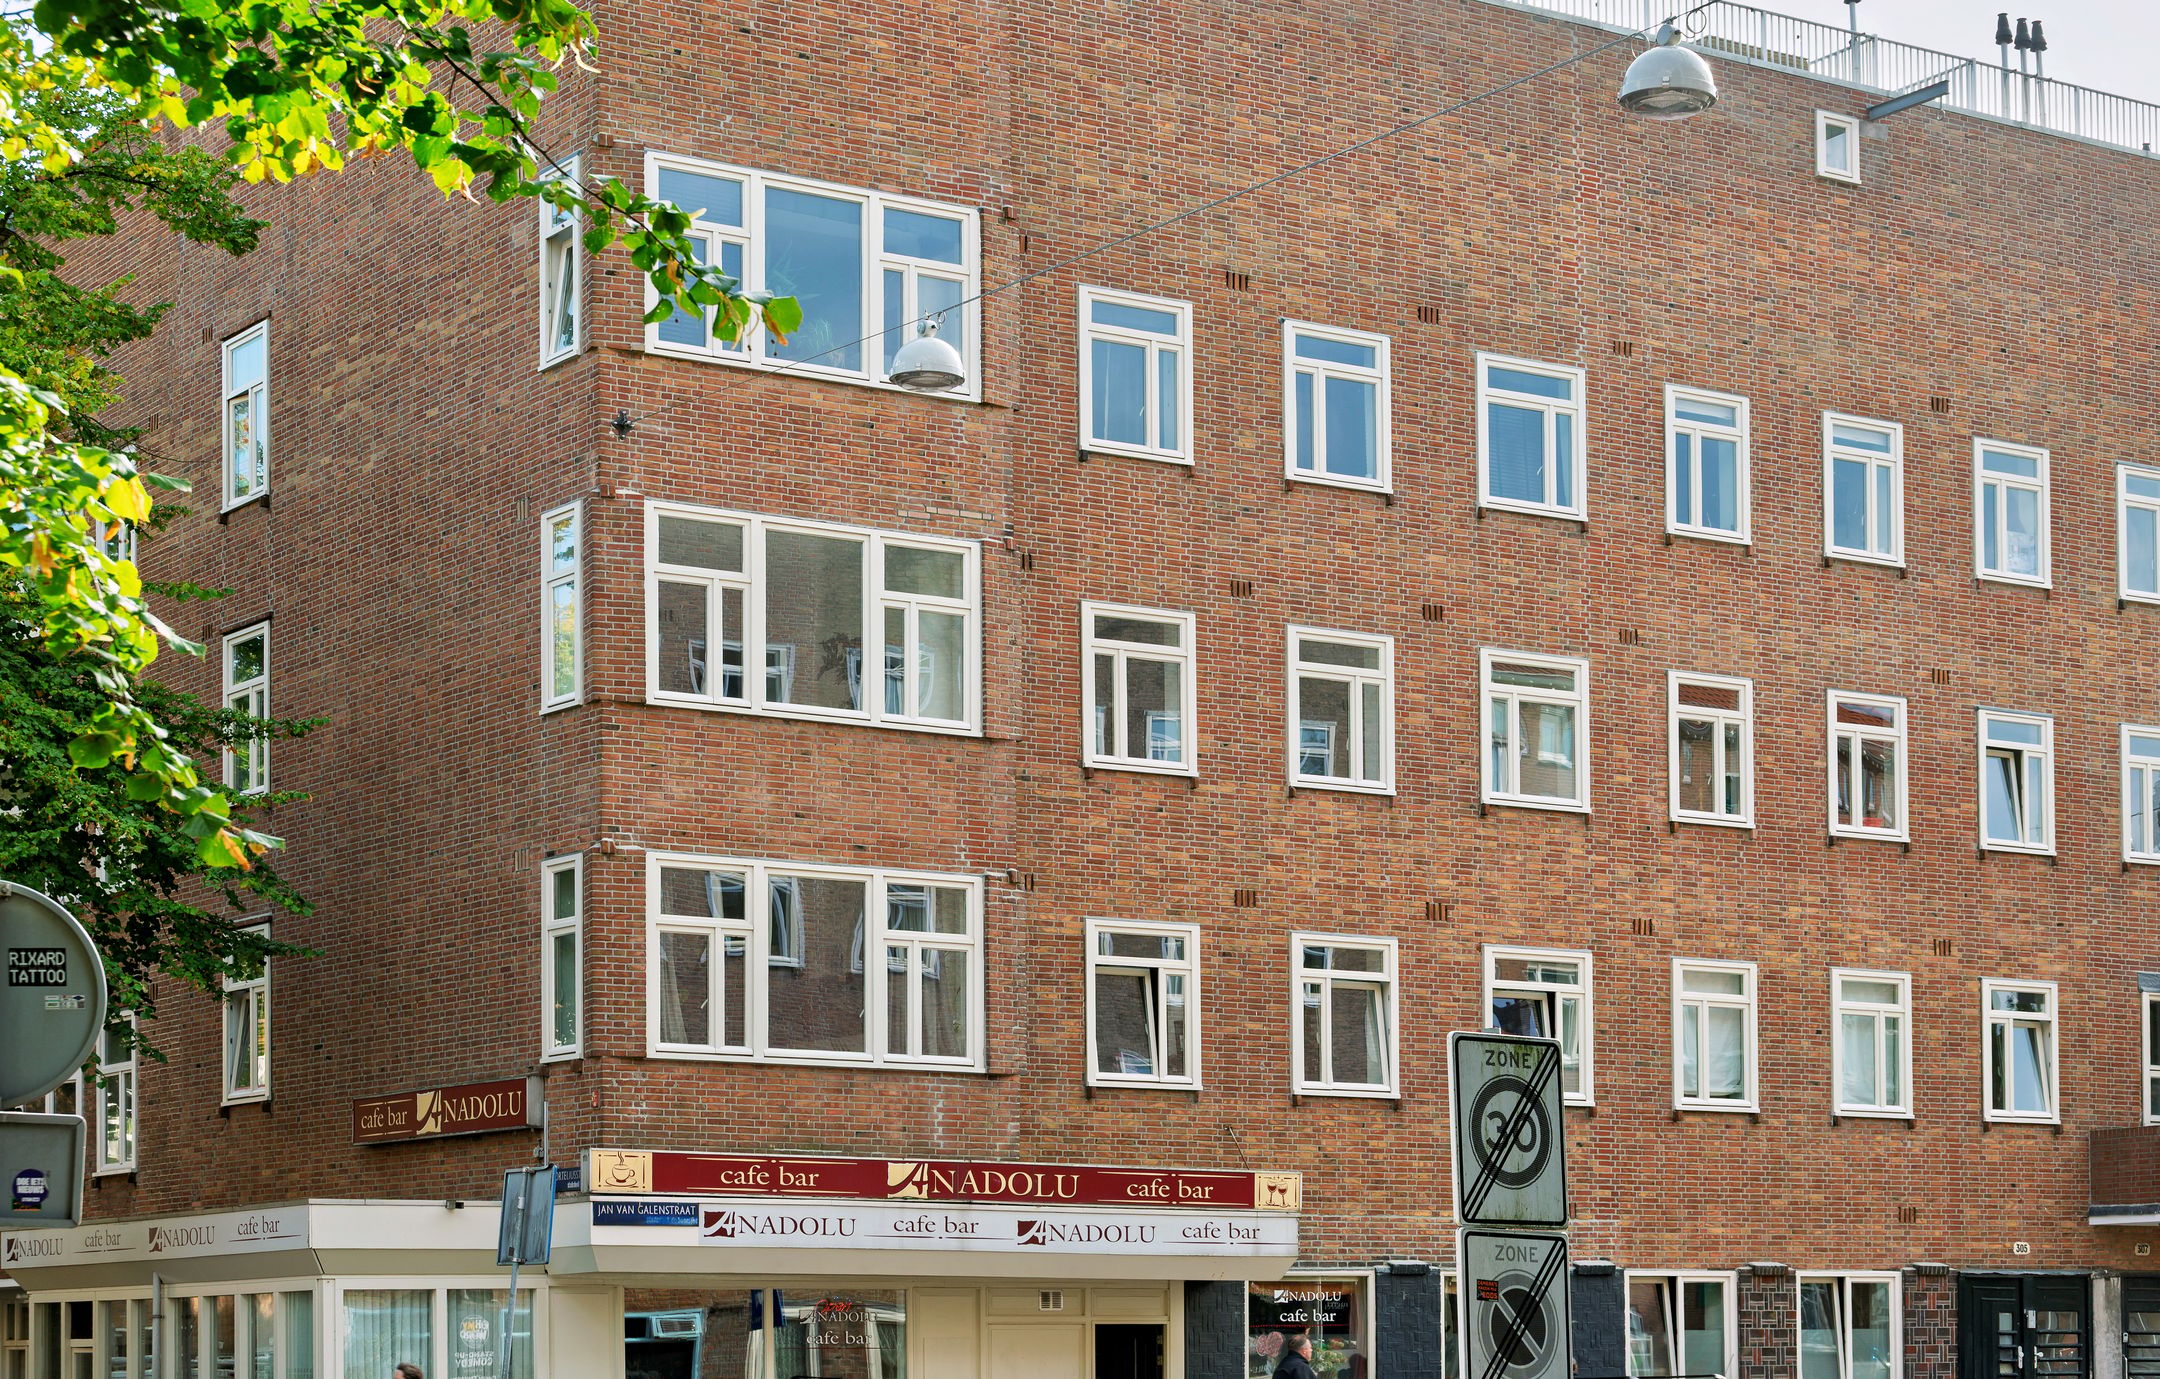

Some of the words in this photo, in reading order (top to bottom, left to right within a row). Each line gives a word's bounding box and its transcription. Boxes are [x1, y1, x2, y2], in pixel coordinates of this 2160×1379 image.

[9, 952, 65, 966] RIXARD
[9, 969, 66, 983] TATTOO
[1485, 1050, 1532, 1069] ZONE
[361, 1105, 384, 1129] cafe
[388, 1105, 408, 1127] bar
[416, 1090, 522, 1135] ANADOLU
[1486, 1110, 1537, 1153] 30
[720, 1165, 770, 1186] cafe
[779, 1166, 820, 1187] bar
[887, 1162, 1080, 1199] ANADOLU
[1126, 1178, 1170, 1200] cafe
[1179, 1180, 1214, 1200] bar
[597, 1205, 613, 1216] JAN
[616, 1205, 634, 1214] VAN
[638, 1205, 696, 1215] GALENSTRAAT
[703, 1210, 856, 1238] ANADOLU
[893, 1215, 936, 1233] cafe
[945, 1217, 979, 1235] bar
[1017, 1219, 1156, 1246] ANADOLU
[1182, 1221, 1221, 1239] cafe
[1229, 1222, 1260, 1240] bar
[6, 1237, 63, 1262] ANADOLU
[84, 1229, 103, 1248] cafe
[106, 1229, 121, 1246] bar
[149, 1226, 215, 1253] ANADOLU
[237, 1216, 259, 1236] cafe
[262, 1215, 280, 1234] bar
[1495, 1245, 1539, 1263] ZONE
[1274, 1289, 1342, 1303] ANADOLU
[1280, 1309, 1308, 1322] cafe
[1313, 1309, 1336, 1322] bar
[807, 1331, 839, 1345] cafe
[845, 1331, 872, 1345] bar
